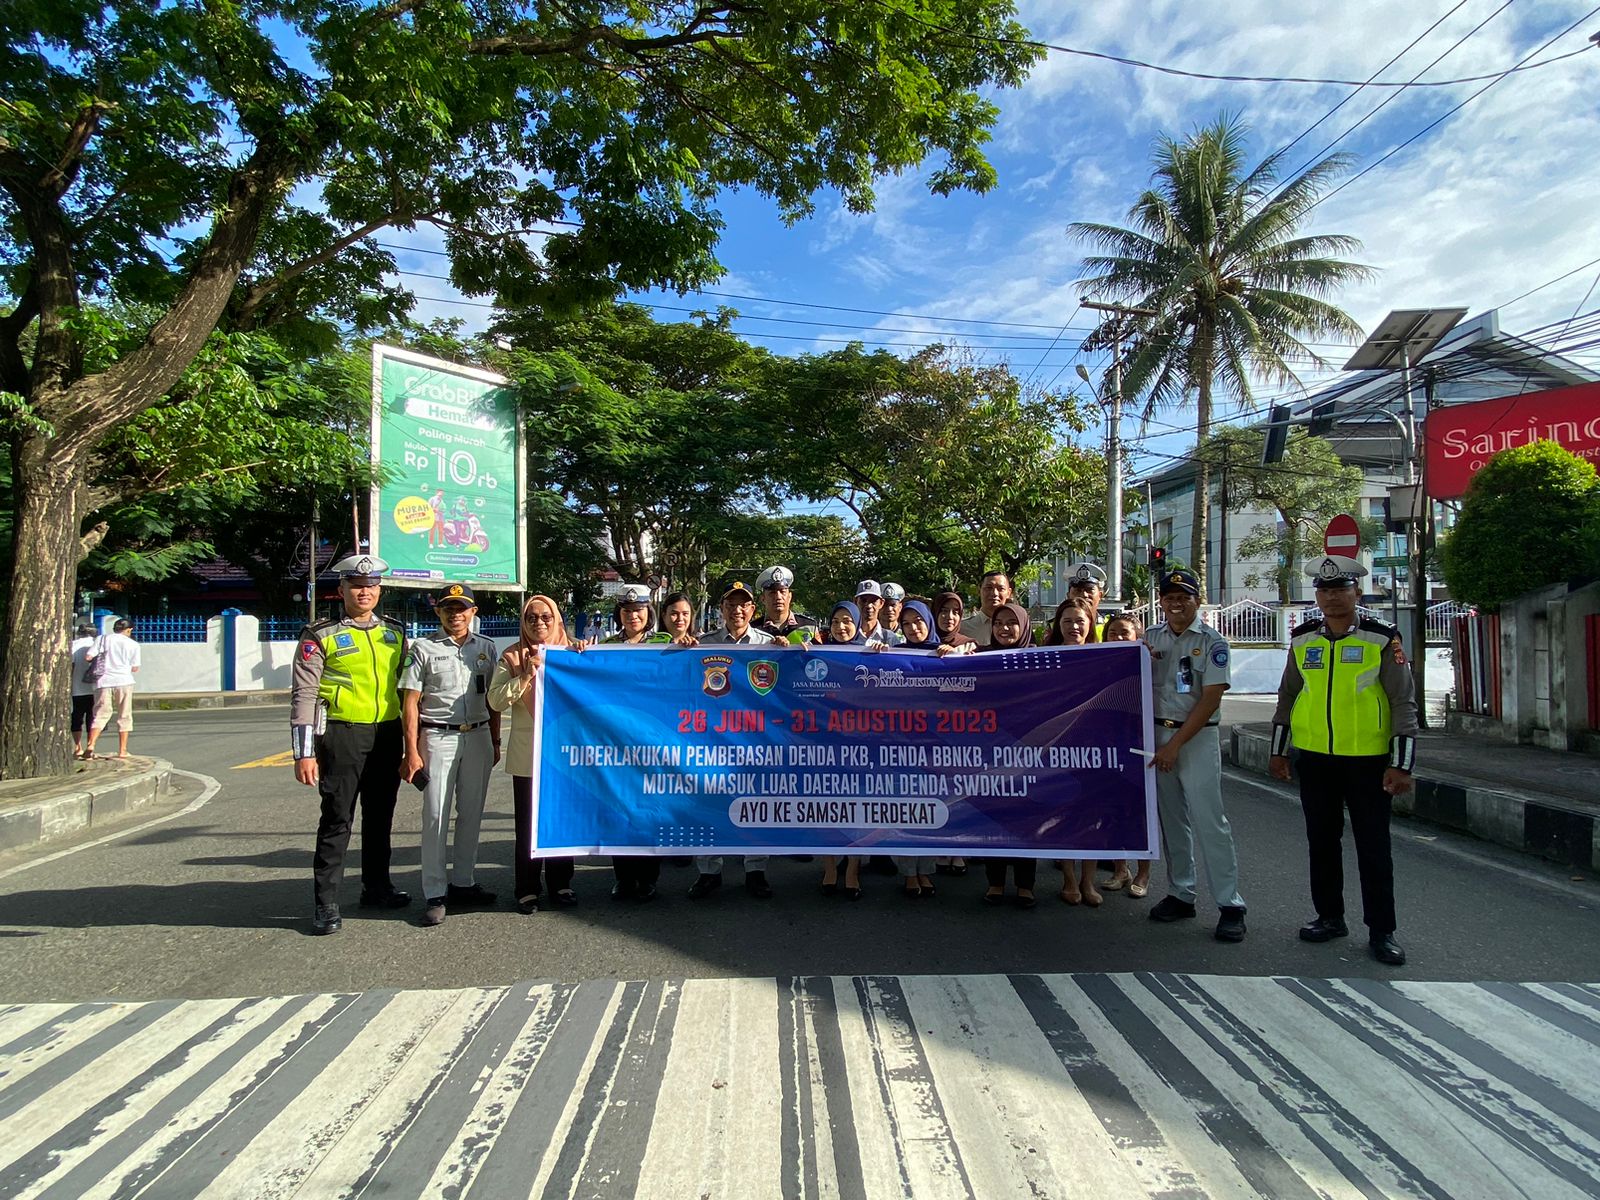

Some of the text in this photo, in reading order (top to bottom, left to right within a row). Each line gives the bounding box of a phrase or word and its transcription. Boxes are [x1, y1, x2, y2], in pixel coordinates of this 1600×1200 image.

[418, 428, 452, 443] Paling
[405, 450, 429, 471] Rp
[430, 447, 477, 485] 10
[478, 472, 498, 489] rb
[397, 504, 429, 515] MURAH
[703, 656, 732, 664] MALUKU
[880, 668, 904, 679] bank
[810, 681, 841, 689] RAHARJA
[678, 709, 707, 734] 26
[713, 709, 765, 734] JUNI
[791, 709, 820, 734] 31
[827, 709, 928, 734] AGUSTUS
[935, 709, 998, 734] 2023
[561, 745, 680, 767] "DIBERLAKUKAN
[686, 745, 782, 768] PEMBEBASAN
[788, 746, 837, 768] DENDA
[841, 746, 874, 770] PKB,
[880, 746, 928, 768] DENDA
[932, 746, 987, 771] BBNKB,
[993, 746, 1043, 769] POKOK
[1049, 747, 1100, 769] BBNKB
[643, 773, 1037, 797] MUTASI MASUK LUAR DAERAH DAN DENDA SWDKLLJ"
[738, 801, 937, 825] AYO KE SAMSAT TERDEKAT
